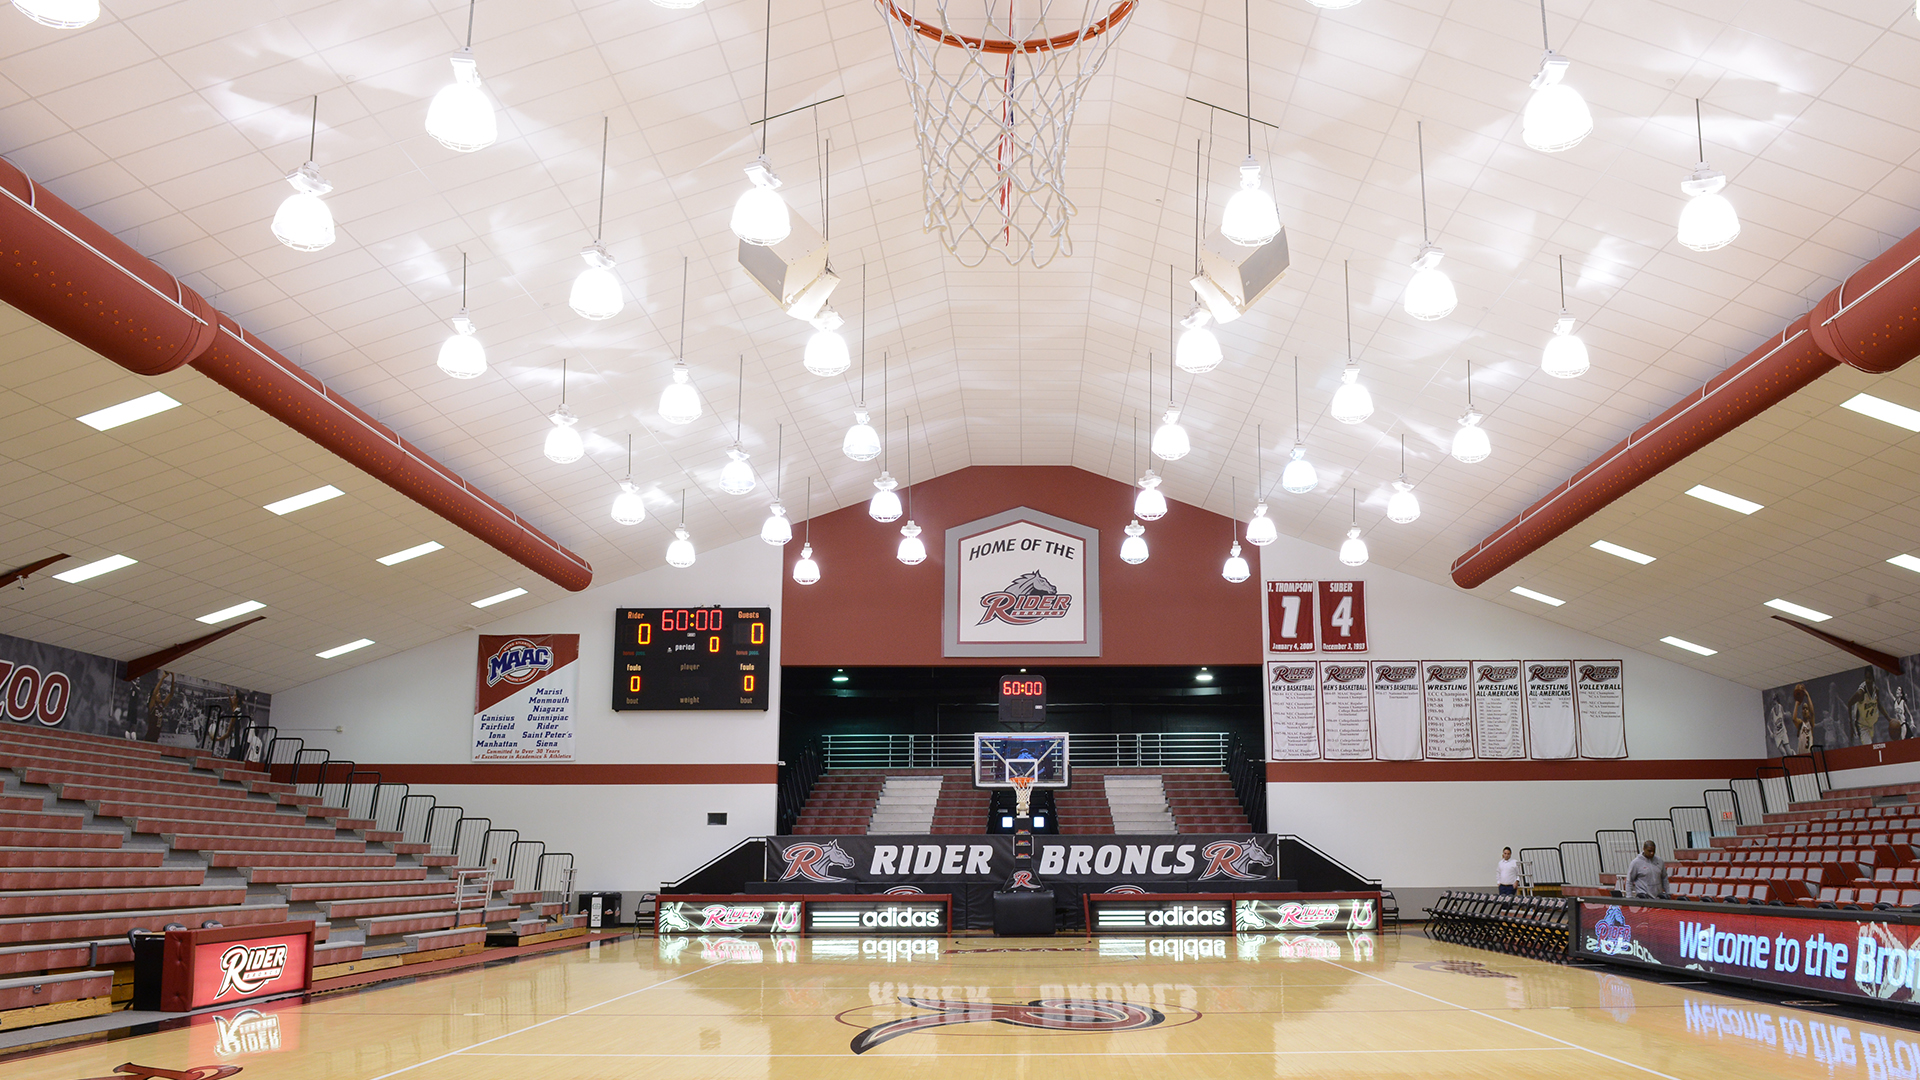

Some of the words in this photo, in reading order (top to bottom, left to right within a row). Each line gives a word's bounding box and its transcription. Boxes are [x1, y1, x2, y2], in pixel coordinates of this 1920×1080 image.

[968, 538, 1017, 561] HOME
[1020, 538, 1042, 551] OF
[1045, 541, 1076, 560] THE
[1275, 583, 1313, 592] THOMPSON
[1330, 583, 1353, 592] SUBER
[627, 612, 644, 620] Rider
[738, 611, 760, 619] Guests
[976, 592, 1072, 625] RIDER
[1281, 596, 1301, 638] 1
[1332, 596, 1354, 637] 4
[662, 609, 723, 631] 60:00
[638, 623, 651, 645] 0
[751, 622, 764, 645] 0
[674, 643, 695, 652] period
[709, 636, 720, 653] 0
[488, 646, 552, 686] MAAC
[680, 663, 700, 671] player
[740, 663, 755, 671] fouls
[1272, 665, 1315, 683] RIDER
[1323, 665, 1366, 683] RIDER
[1375, 665, 1417, 683] RIDER
[1426, 665, 1468, 683] RIDER
[1476, 664, 1518, 683] RIDER
[1528, 664, 1570, 682] RIDER
[1578, 664, 1620, 683] RIDER
[630, 675, 641, 692] 0
[744, 675, 754, 692] 0
[1003, 681, 1043, 696] 60:00
[532, 706, 564, 714] Niagara
[679, 697, 700, 705] weight
[527, 714, 569, 722] Quinnipiac
[870, 845, 994, 875] RIDER
[1038, 845, 1196, 875] BRONCS
[701, 904, 764, 930] RIDER
[862, 907, 939, 927] adidas
[1149, 905, 1226, 926] adidas
[1278, 902, 1340, 927] RIDER
[1679, 921, 1770, 970] Welcome
[1775, 932, 1801, 972] to
[1804, 933, 1848, 979] the
[214, 944, 287, 1000] RIDER
